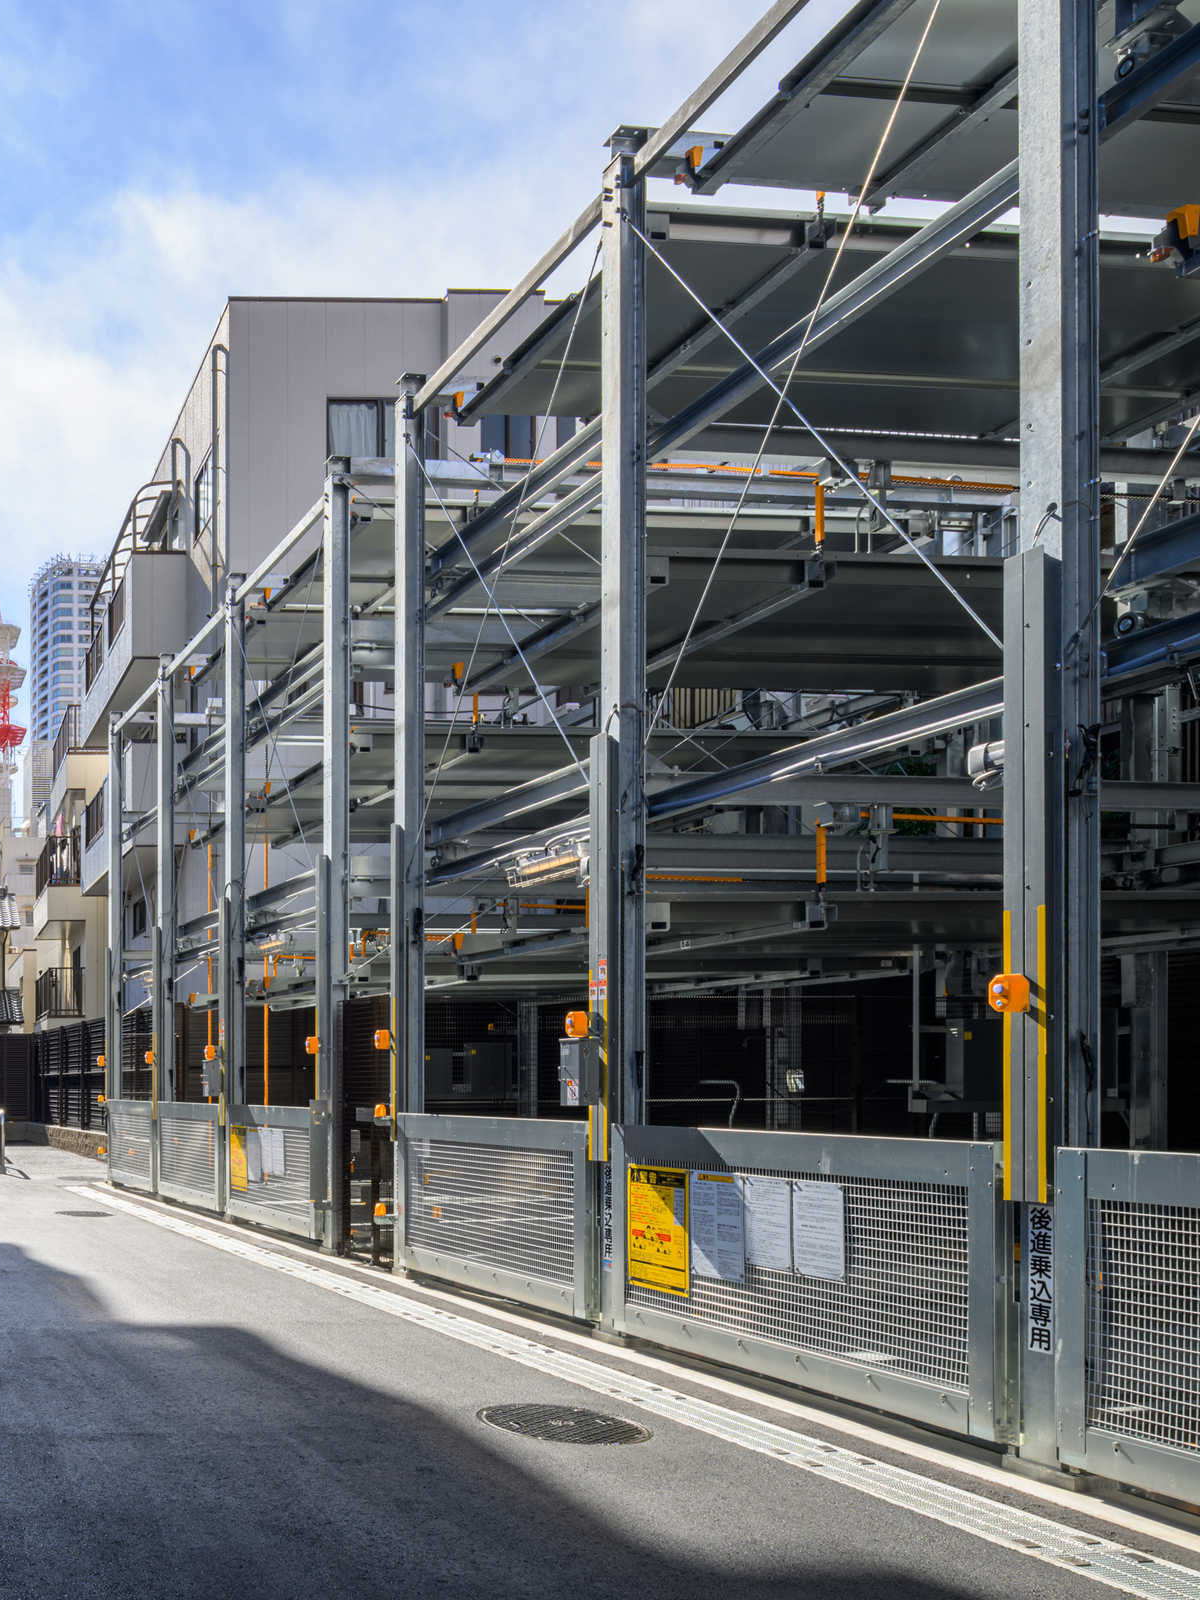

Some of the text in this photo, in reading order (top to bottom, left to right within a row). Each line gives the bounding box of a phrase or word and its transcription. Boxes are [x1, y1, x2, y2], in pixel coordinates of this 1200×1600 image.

[639, 1170, 657, 1185] 警告
[1029, 1207, 1052, 1352] 後進乗込専用
